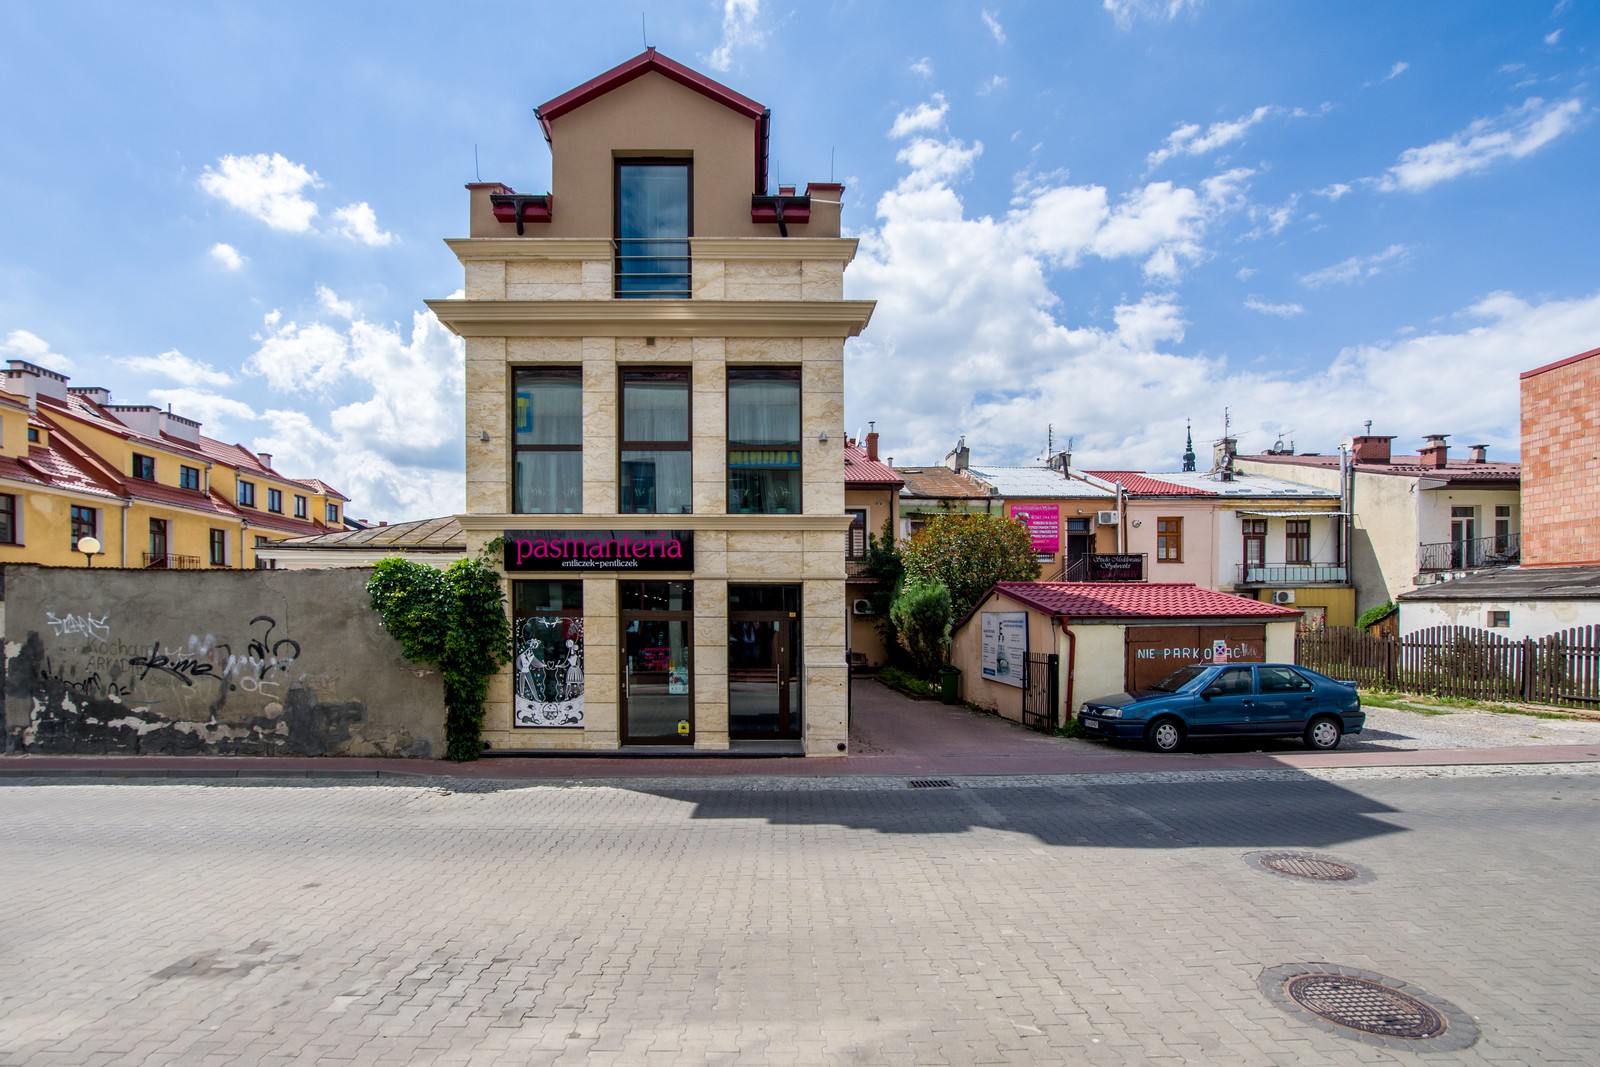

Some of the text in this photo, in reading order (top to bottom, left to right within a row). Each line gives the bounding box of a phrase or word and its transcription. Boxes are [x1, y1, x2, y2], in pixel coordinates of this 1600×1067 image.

[516, 533, 682, 565] pasmanteria
[561, 559, 638, 568] entliczek-pentliczek
[1137, 648, 1155, 659] NIE
